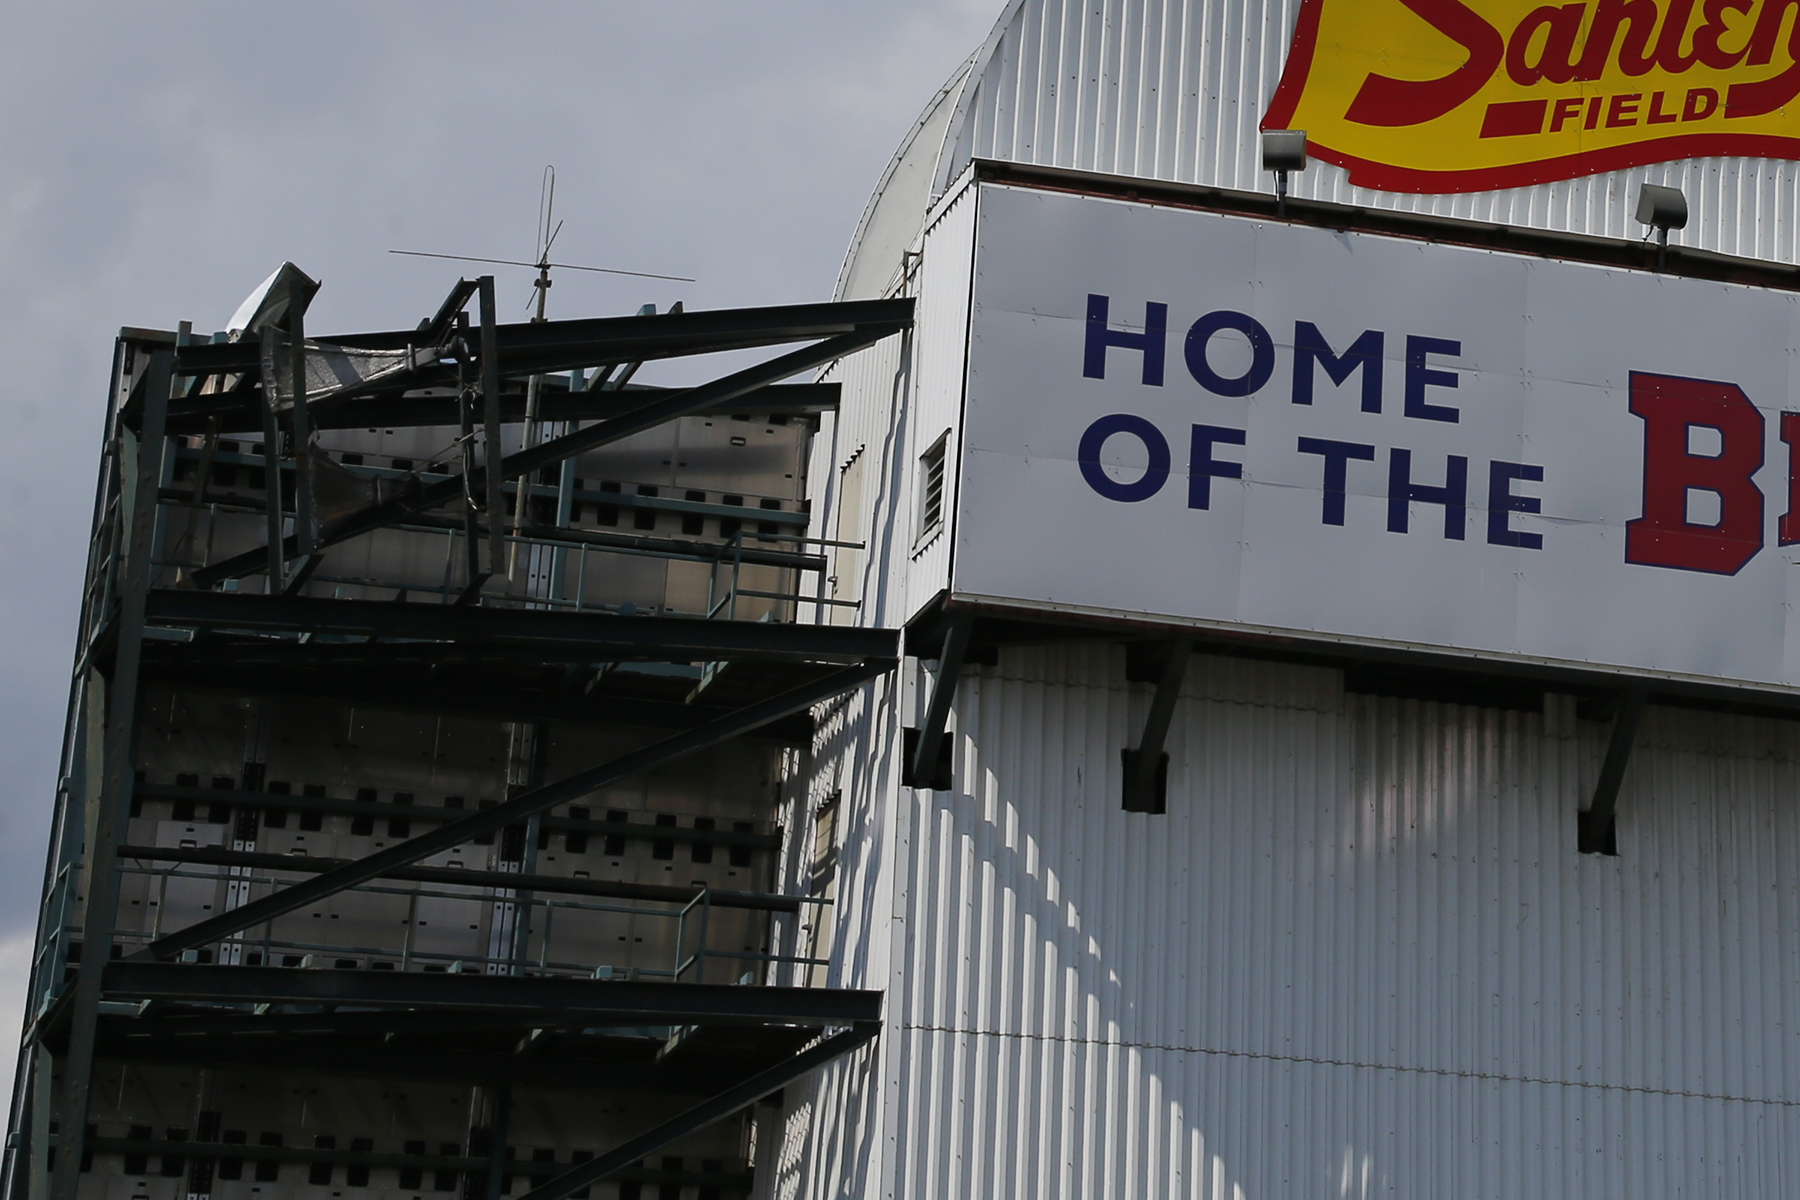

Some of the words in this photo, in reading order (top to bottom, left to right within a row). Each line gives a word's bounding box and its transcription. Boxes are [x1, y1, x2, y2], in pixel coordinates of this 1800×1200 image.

[1549, 87, 1717, 133] FIELD
[1081, 293, 1462, 424] HOME
[1077, 412, 1246, 511] OF
[1297, 436, 1545, 550] THE
